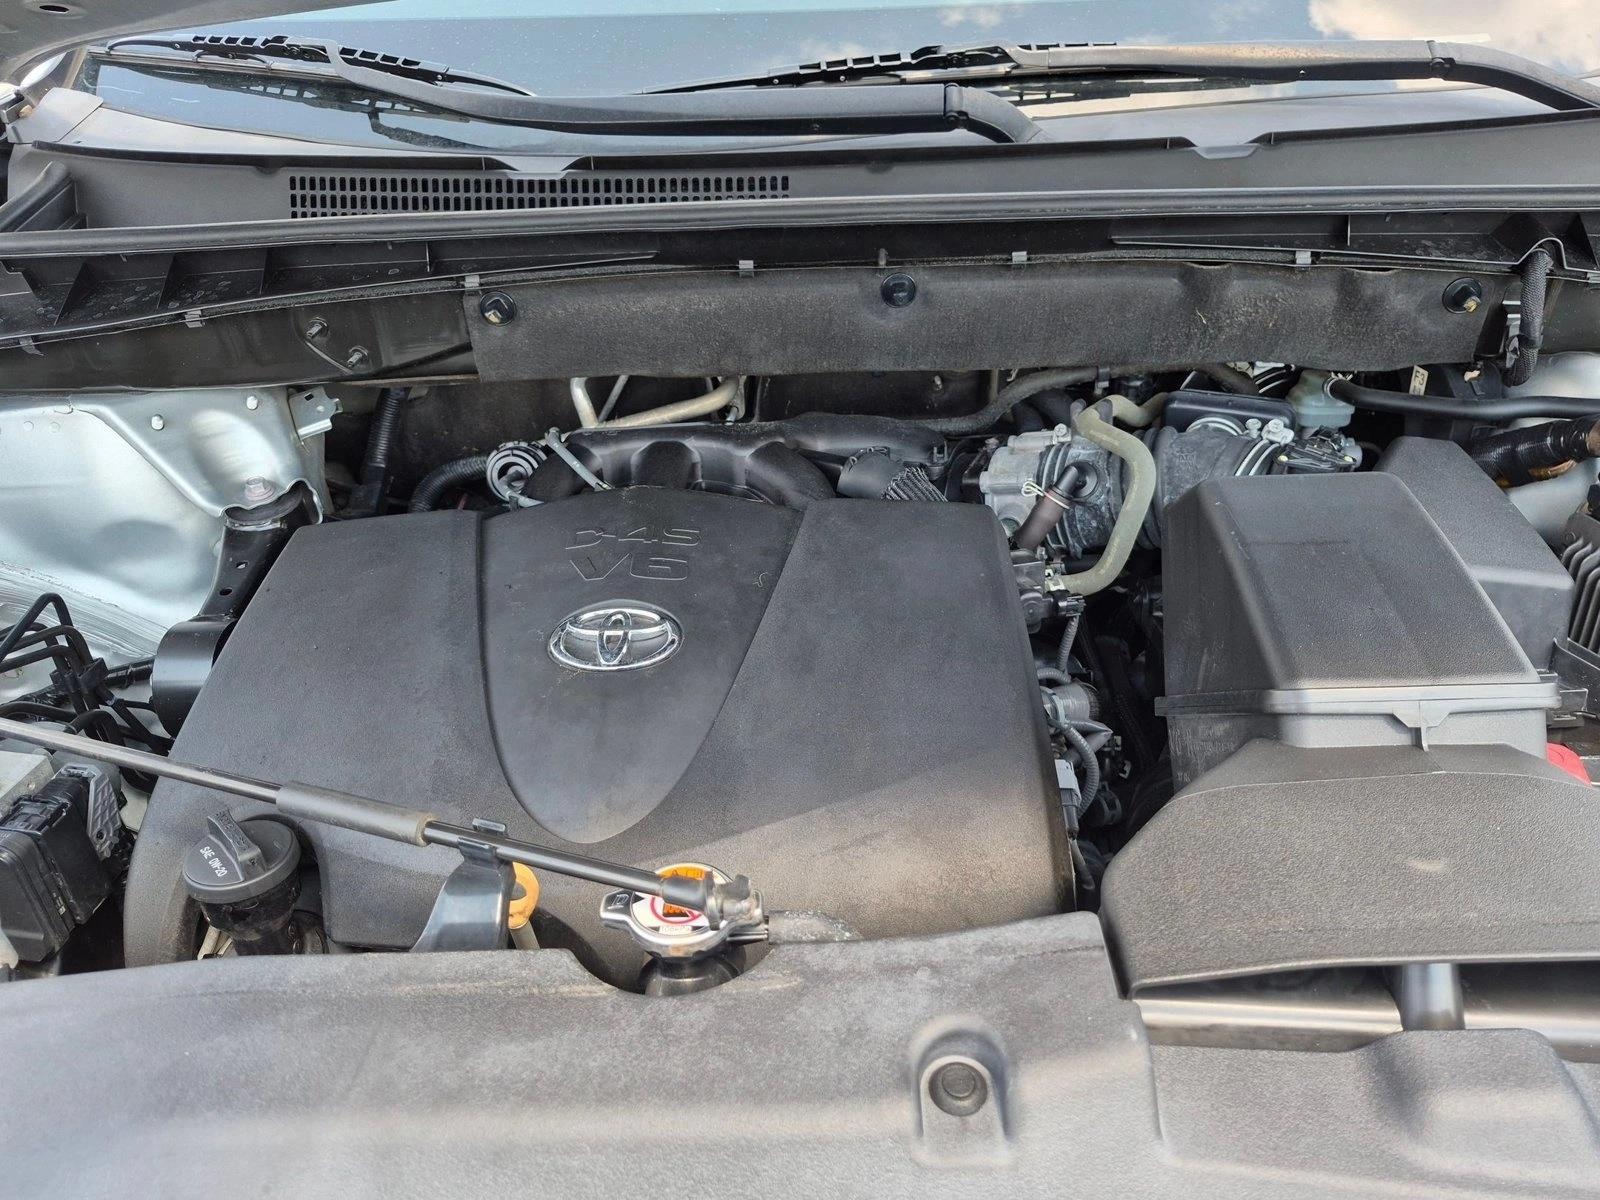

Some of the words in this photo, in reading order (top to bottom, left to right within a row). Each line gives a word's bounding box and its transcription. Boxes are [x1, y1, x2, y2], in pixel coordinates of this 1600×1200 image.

[569, 552, 689, 581] V6
[200, 846, 215, 860] SAE
[208, 857, 228, 878] 0W-20
